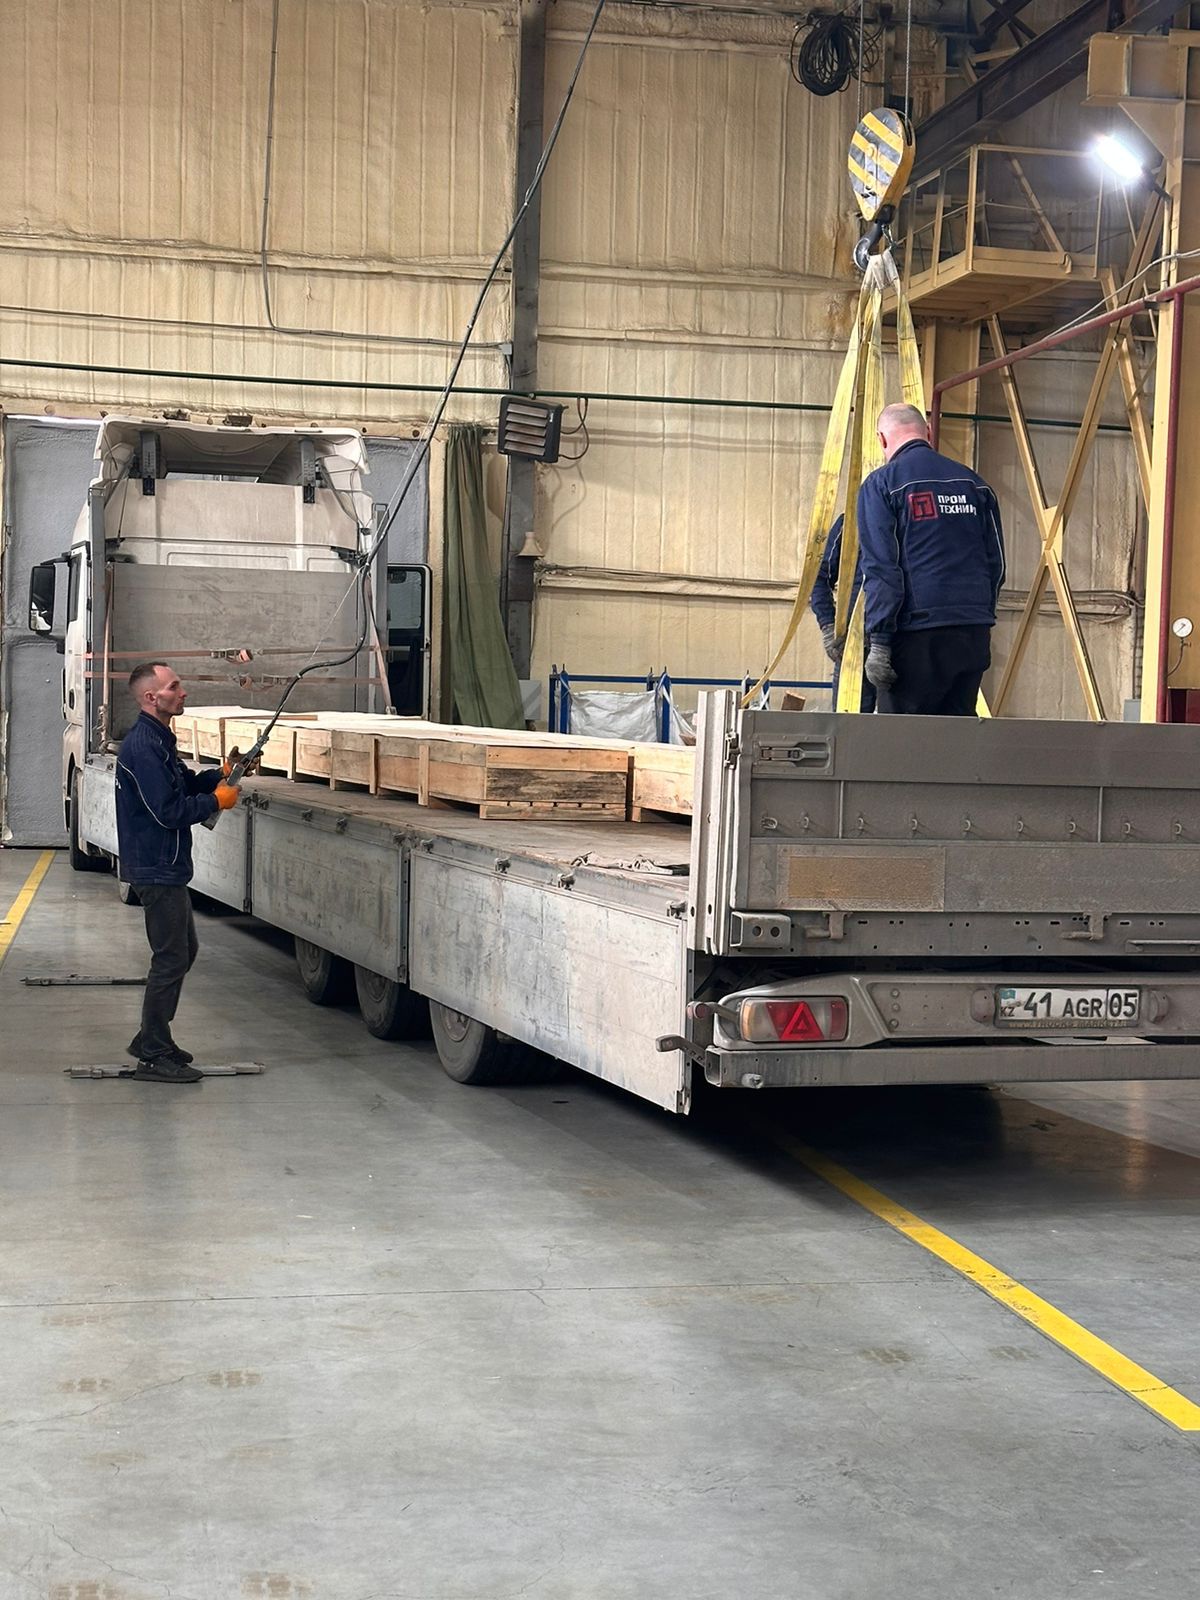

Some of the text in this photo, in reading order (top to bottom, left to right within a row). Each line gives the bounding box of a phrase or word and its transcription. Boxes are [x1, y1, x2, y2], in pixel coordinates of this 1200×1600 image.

[937, 494, 967, 504] ПРОМ
[1023, 991, 1138, 1018] 41 AGR 05
